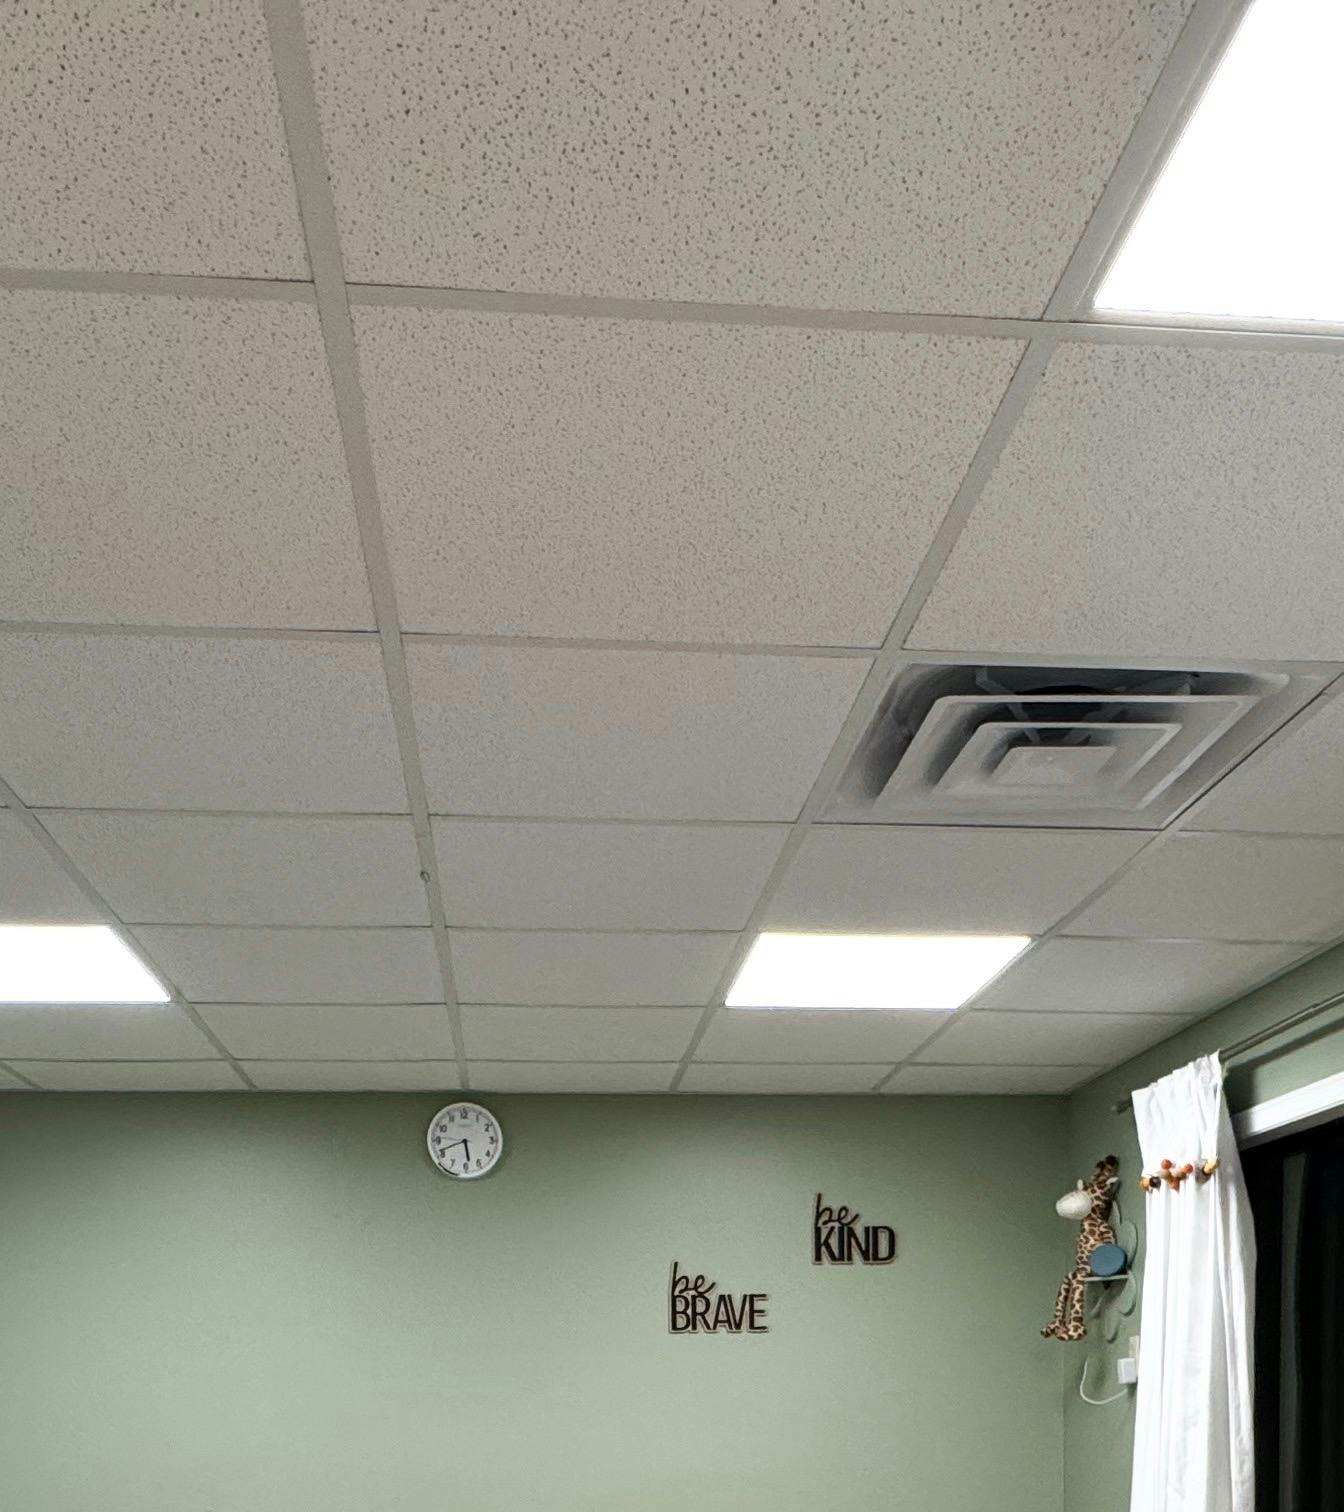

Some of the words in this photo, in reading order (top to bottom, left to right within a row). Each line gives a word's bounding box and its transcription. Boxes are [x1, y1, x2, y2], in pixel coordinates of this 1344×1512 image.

[814, 1193, 861, 1227] be
[814, 1225, 896, 1262] KIND
[671, 1261, 717, 1295] be
[671, 1293, 768, 1331] BRAVE
